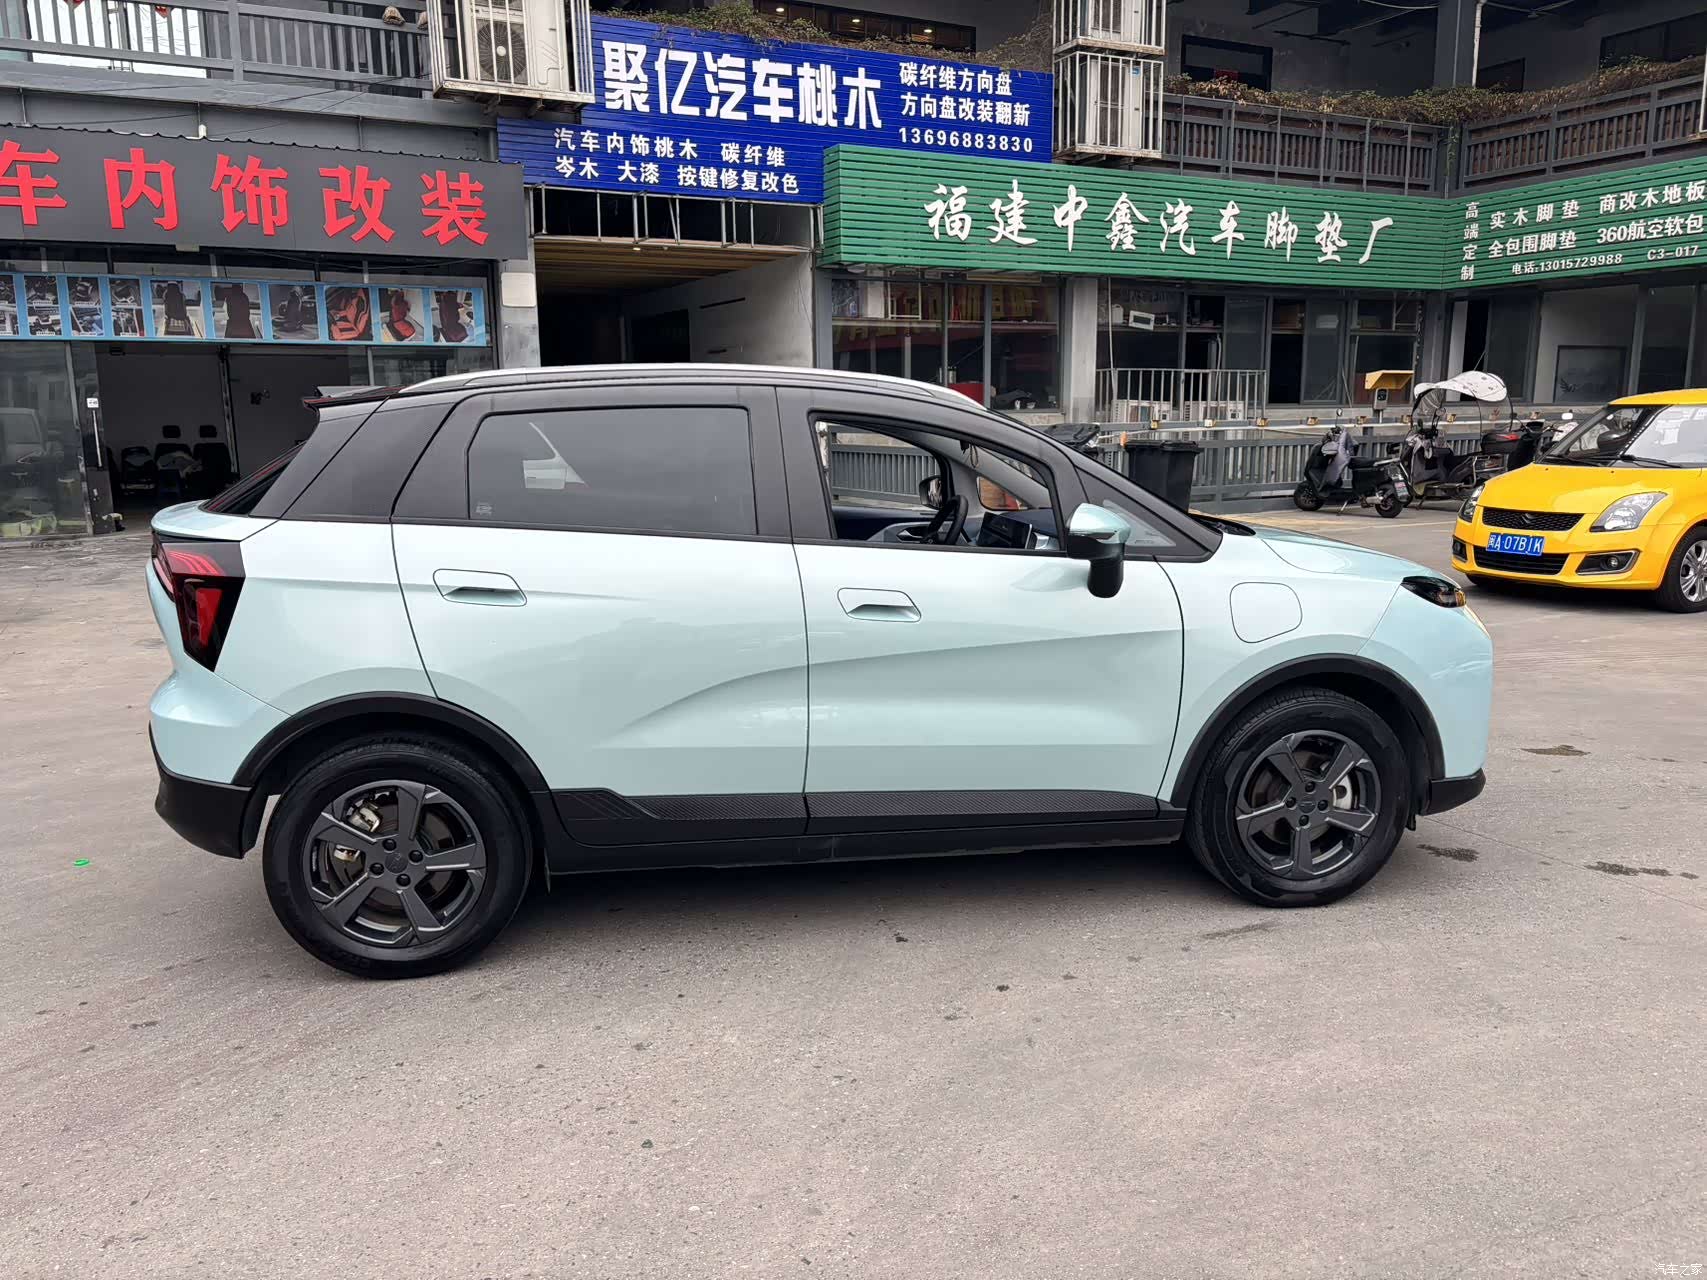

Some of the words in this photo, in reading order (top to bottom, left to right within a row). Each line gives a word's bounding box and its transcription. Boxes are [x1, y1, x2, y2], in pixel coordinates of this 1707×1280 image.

[602, 40, 882, 130] 聚亿汽车桃木
[899, 61, 1012, 96] 碳纤维方向盘
[901, 92, 1030, 126] 方向盘改装翻新
[554, 128, 698, 160] 汽车内饰桃木
[721, 142, 786, 167] 碳纤维
[899, 127, 1033, 153] 13696883830
[0, 139, 489, 246] 车内饰改装
[555, 156, 600, 180] 岑木
[617, 160, 660, 184] 大漆
[677, 165, 800, 194] 按键修复改色
[923, 179, 1393, 265] 福建中鑫汽车脚垫厂
[1490, 199, 1580, 229] 实木脚垫
[1599, 180, 1706, 214] 商改木地板
[1460, 201, 1480, 281] 高端定制
[1488, 230, 1577, 259] 全包围脚垫
[1597, 213, 1704, 244] 360航空软包
[1647, 245, 1699, 261] C3-017
